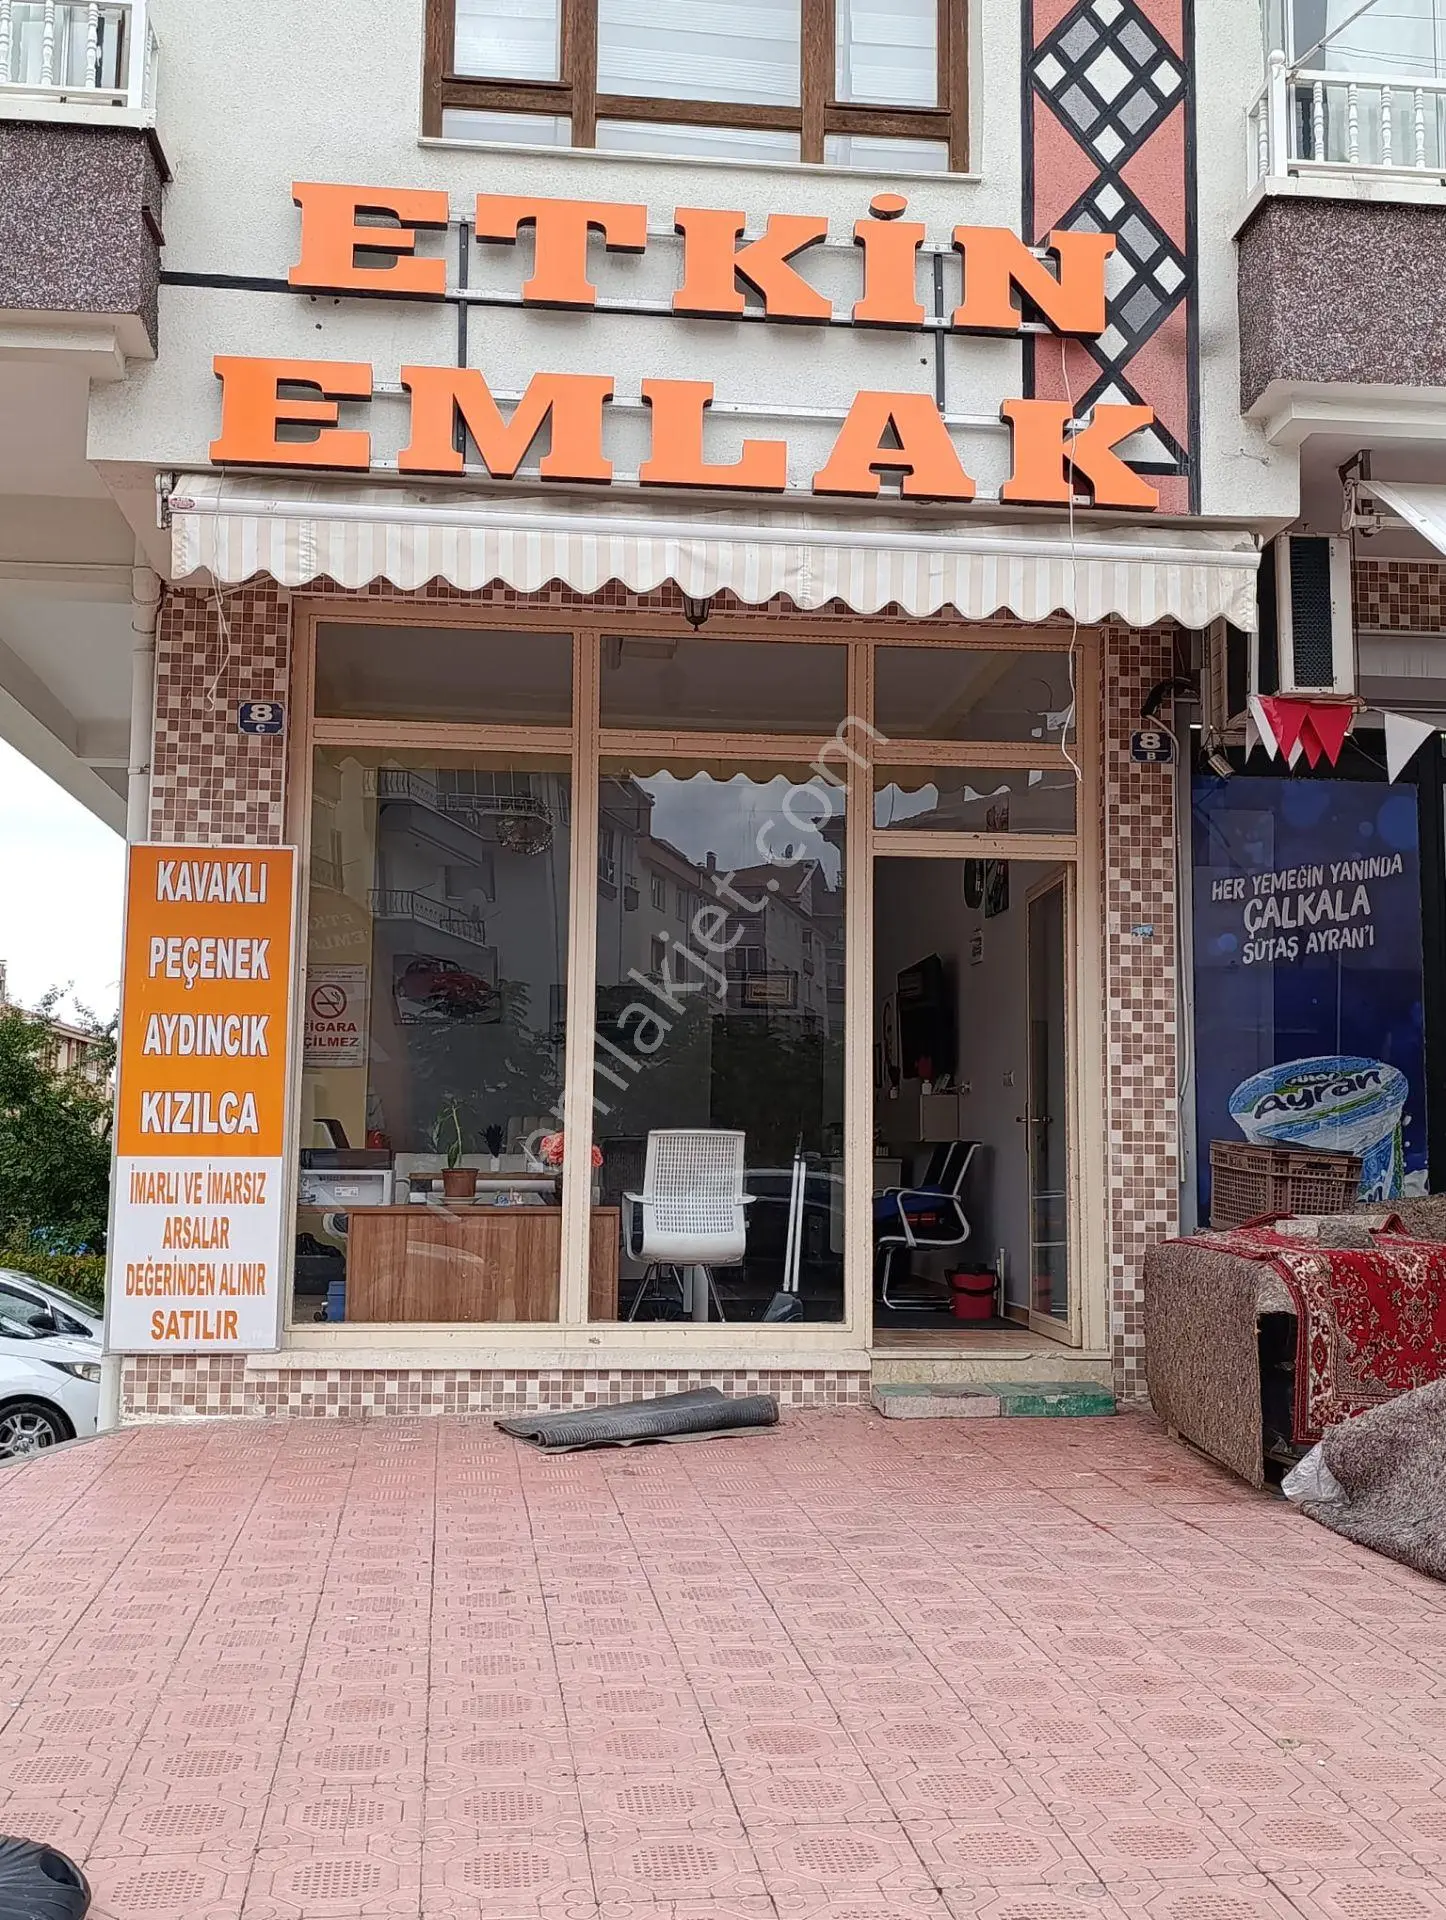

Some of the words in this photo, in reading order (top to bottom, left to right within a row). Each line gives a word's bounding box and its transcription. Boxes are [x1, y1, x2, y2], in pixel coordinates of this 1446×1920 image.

[289, 181, 1116, 337] ETKİN
[209, 355, 1159, 509] EMLAK
[249, 704, 273, 721] 8
[1139, 733, 1161, 749] 8
[1146, 752, 1156, 760] B
[156, 860, 268, 903] KAVAKLI
[1212, 878, 1245, 900] HER
[1252, 864, 1324, 896] YEMEĞİN
[1330, 853, 1403, 884] YANINDA
[1243, 884, 1371, 939] ÇALKALA
[148, 936, 271, 990] PEÇENEK
[1242, 936, 1299, 964] SÜTAŞ
[1305, 925, 1375, 954] AYRAN'I
[142, 1013, 271, 1057] AYDINCIK
[304, 1035, 360, 1049] ÇİLMEZ
[140, 1091, 260, 1135] KIZILCA
[1254, 1070, 1382, 1119] Ayran
[130, 1163, 180, 1205] İMARLI
[183, 1172, 203, 1205] VE
[206, 1163, 267, 1205] İMARSIZ
[162, 1216, 230, 1250] ARSALAR
[125, 1255, 216, 1297] DEĞERİNDEN
[218, 1262, 267, 1296] ALINIR
[150, 1309, 239, 1341] SATILIR
